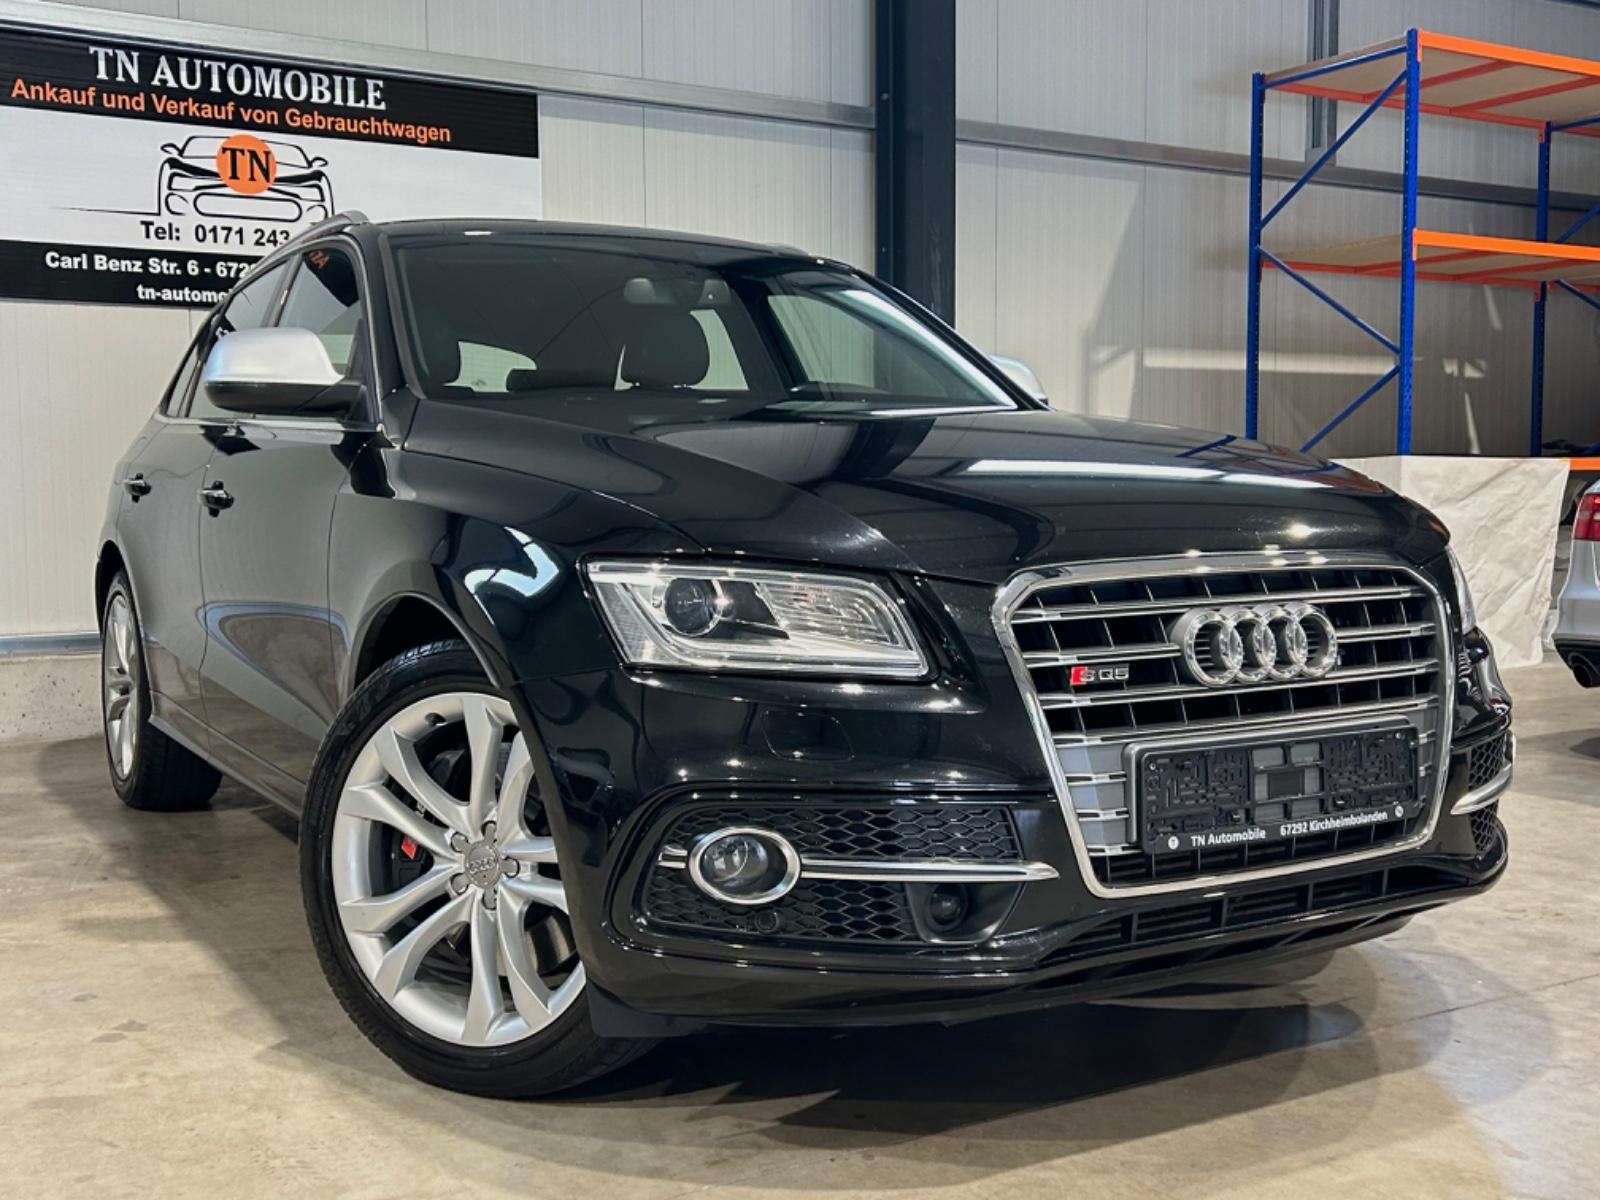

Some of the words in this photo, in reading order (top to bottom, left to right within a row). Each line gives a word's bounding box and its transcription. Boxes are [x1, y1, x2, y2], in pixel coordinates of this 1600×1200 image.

[89, 45, 140, 83] TN
[151, 56, 387, 110] AUTOMOBILE
[11, 78, 96, 107] Ankauf
[102, 89, 146, 112] und
[151, 93, 234, 121] Verkauf
[240, 106, 279, 125] von
[285, 108, 451, 143] Gebrauchtwagen
[222, 147, 272, 184] TN
[140, 221, 180, 242] Tel:
[194, 224, 244, 246] 0171
[45, 251, 88, 270] Carl
[94, 254, 142, 273] Benz
[148, 258, 181, 275] Str.
[187, 260, 199, 275] 6
[137, 285, 232, 303] tn-automo
[1073, 666, 1129, 684] SQ5
[1191, 834, 1206, 848] TN
[1208, 830, 1267, 846] Automobile
[1281, 820, 1308, 836] 67292
[1309, 811, 1388, 831] Kirchheimbolanden
